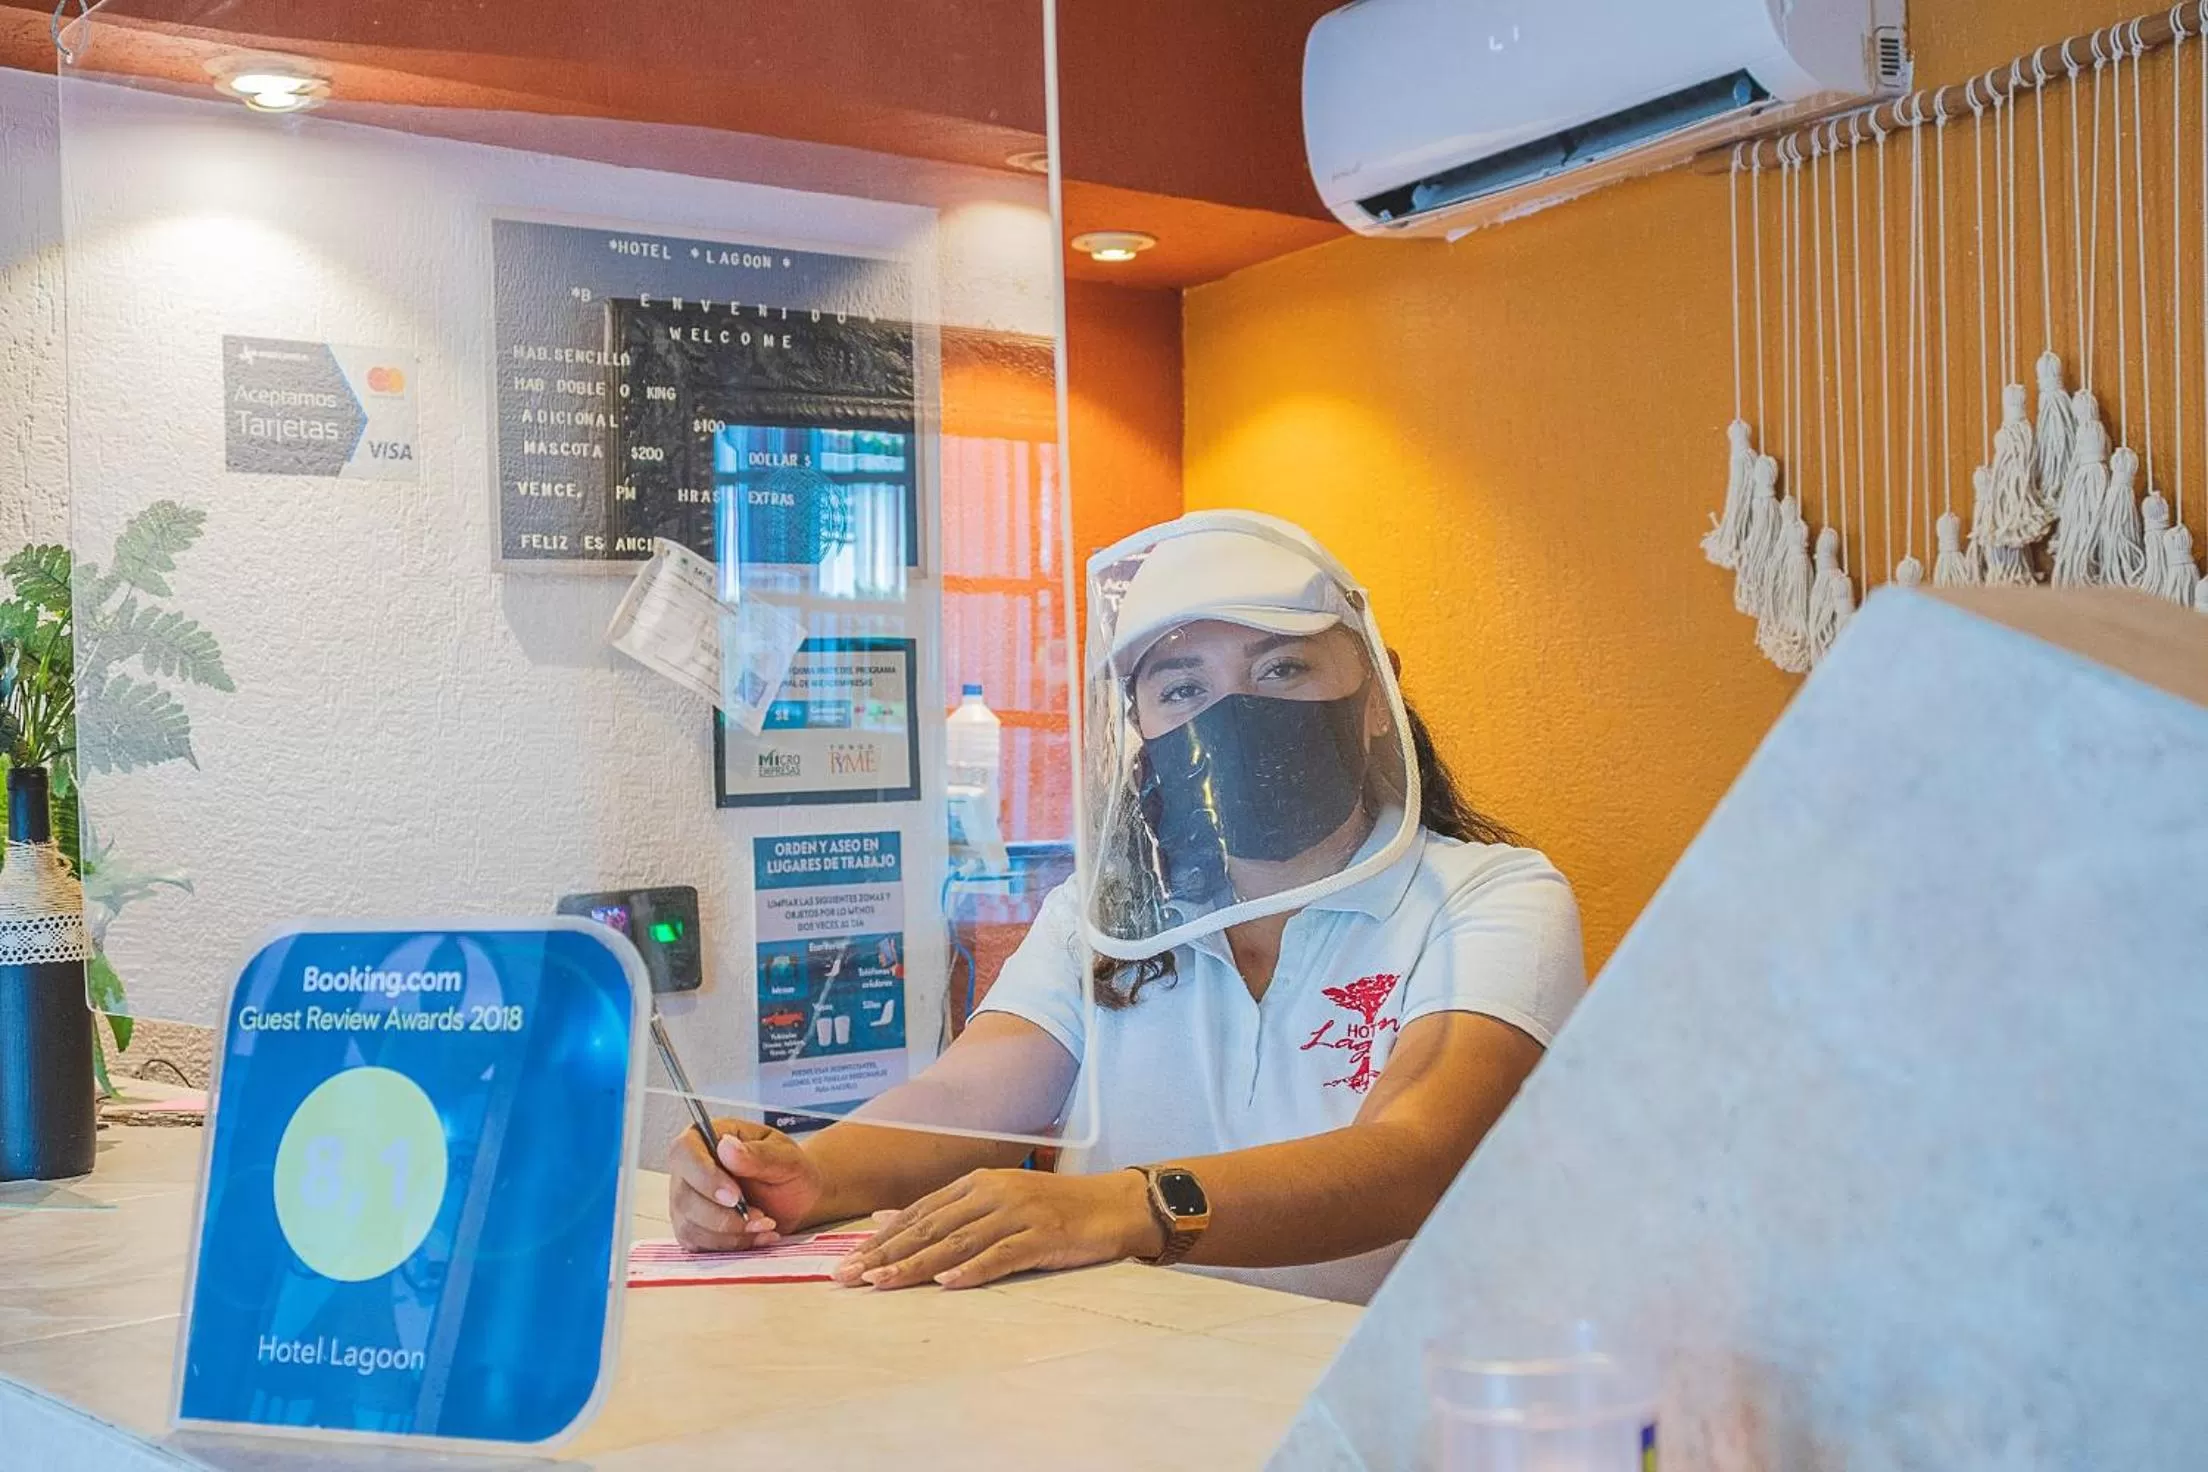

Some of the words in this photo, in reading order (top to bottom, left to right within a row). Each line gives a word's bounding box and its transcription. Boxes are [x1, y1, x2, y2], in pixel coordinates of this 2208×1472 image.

[706, 250, 772, 269] LAGOON
[669, 326, 792, 349] WELCOME
[234, 384, 337, 408] Aceptamos
[557, 379, 606, 396] DOBLE
[646, 386, 677, 401] KING
[235, 409, 339, 442] Tarjetas
[522, 408, 620, 429] ADICIONAL
[369, 441, 413, 461] VISA
[523, 439, 604, 459] MASCOTA
[631, 446, 665, 461] $200
[748, 451, 798, 467] DOLLAR
[616, 485, 637, 500] PM
[747, 489, 796, 506] EXTRAS
[520, 533, 569, 550] FELIZ
[775, 841, 817, 856] ORDEN
[818, 840, 827, 853] Y
[830, 839, 861, 854] ASEO
[863, 837, 879, 851] EN
[767, 857, 822, 874] LUGARES
[824, 857, 839, 871] DE
[841, 854, 896, 869] TRABAJO
[303, 965, 462, 996] Booking.com
[239, 1006, 300, 1031] Guest
[306, 1007, 379, 1031] Review
[384, 1007, 464, 1031] Awards
[469, 1005, 524, 1031] 2018
[257, 1334, 324, 1365] Hotel
[329, 1337, 426, 1376] Lagoon
